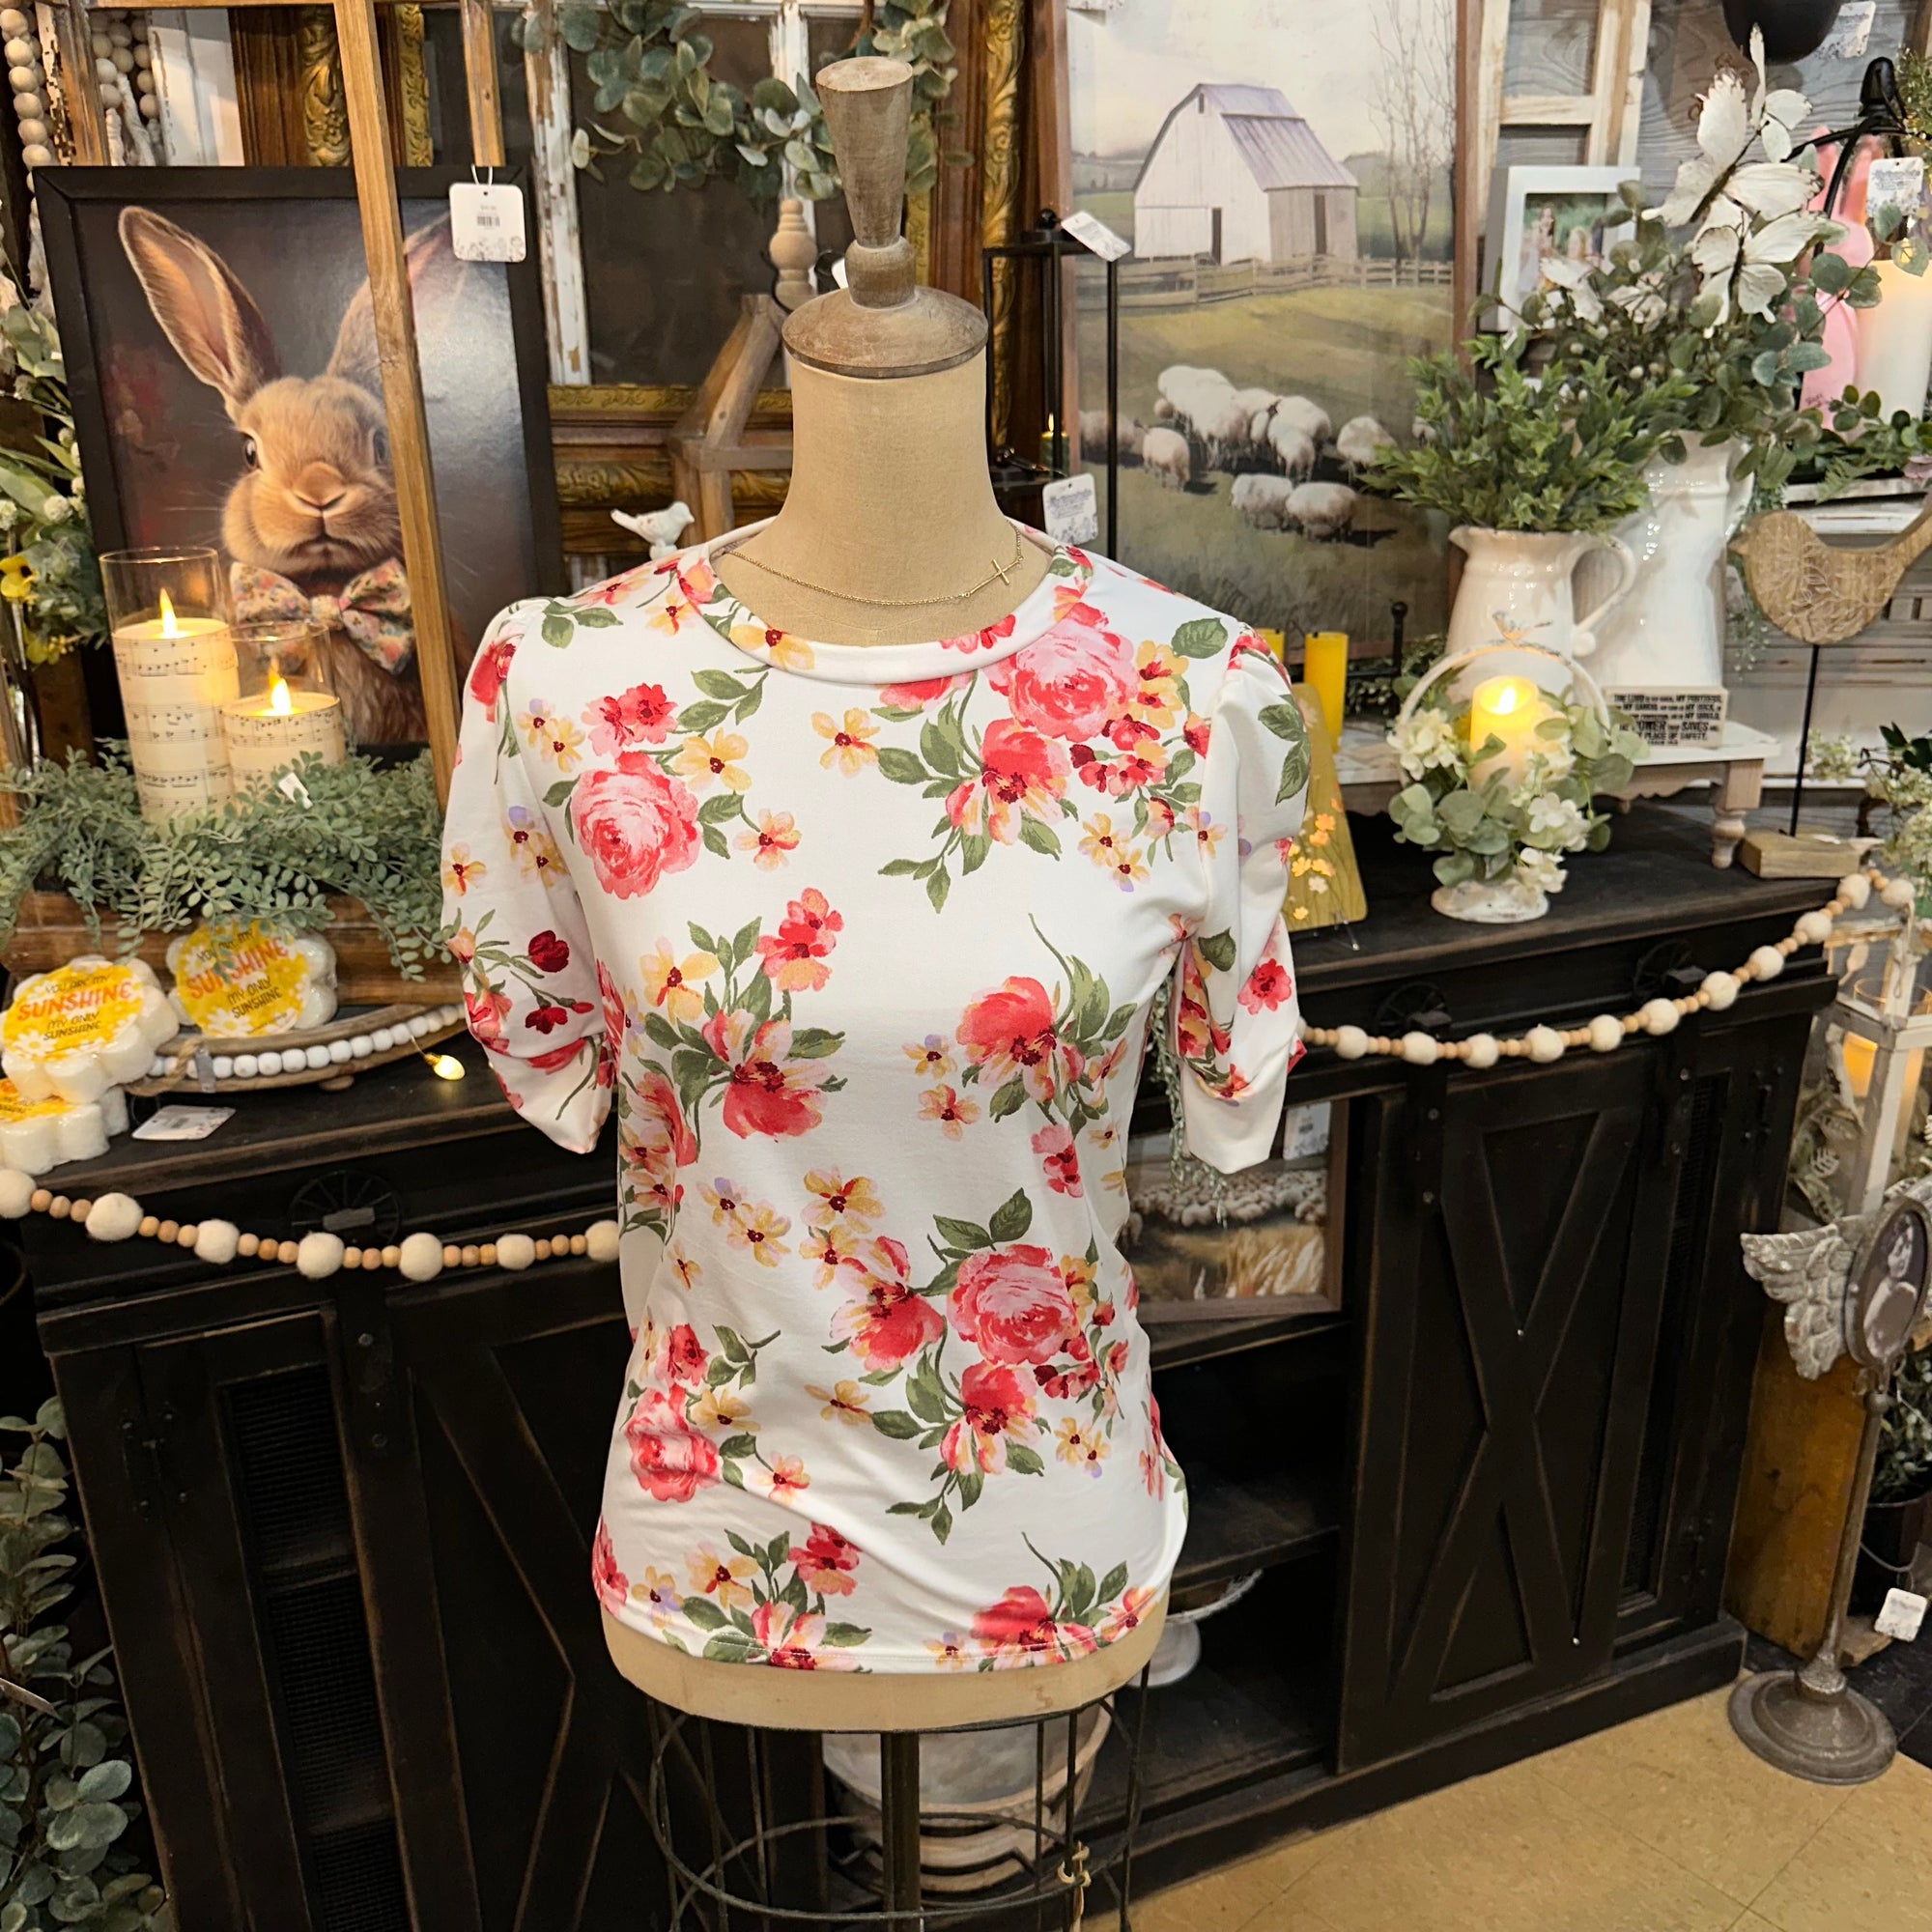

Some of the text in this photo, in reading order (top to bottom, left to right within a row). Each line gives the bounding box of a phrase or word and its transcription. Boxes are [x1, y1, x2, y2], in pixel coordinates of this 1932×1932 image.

[16, 980, 132, 1022] SUNSHINE
[227, 975, 271, 1006] MY ONLY
[232, 986, 282, 1019] SUNSHINE
[43, 1020, 100, 1041] SUNSHINE
[47, 1019, 68, 1031] MY
